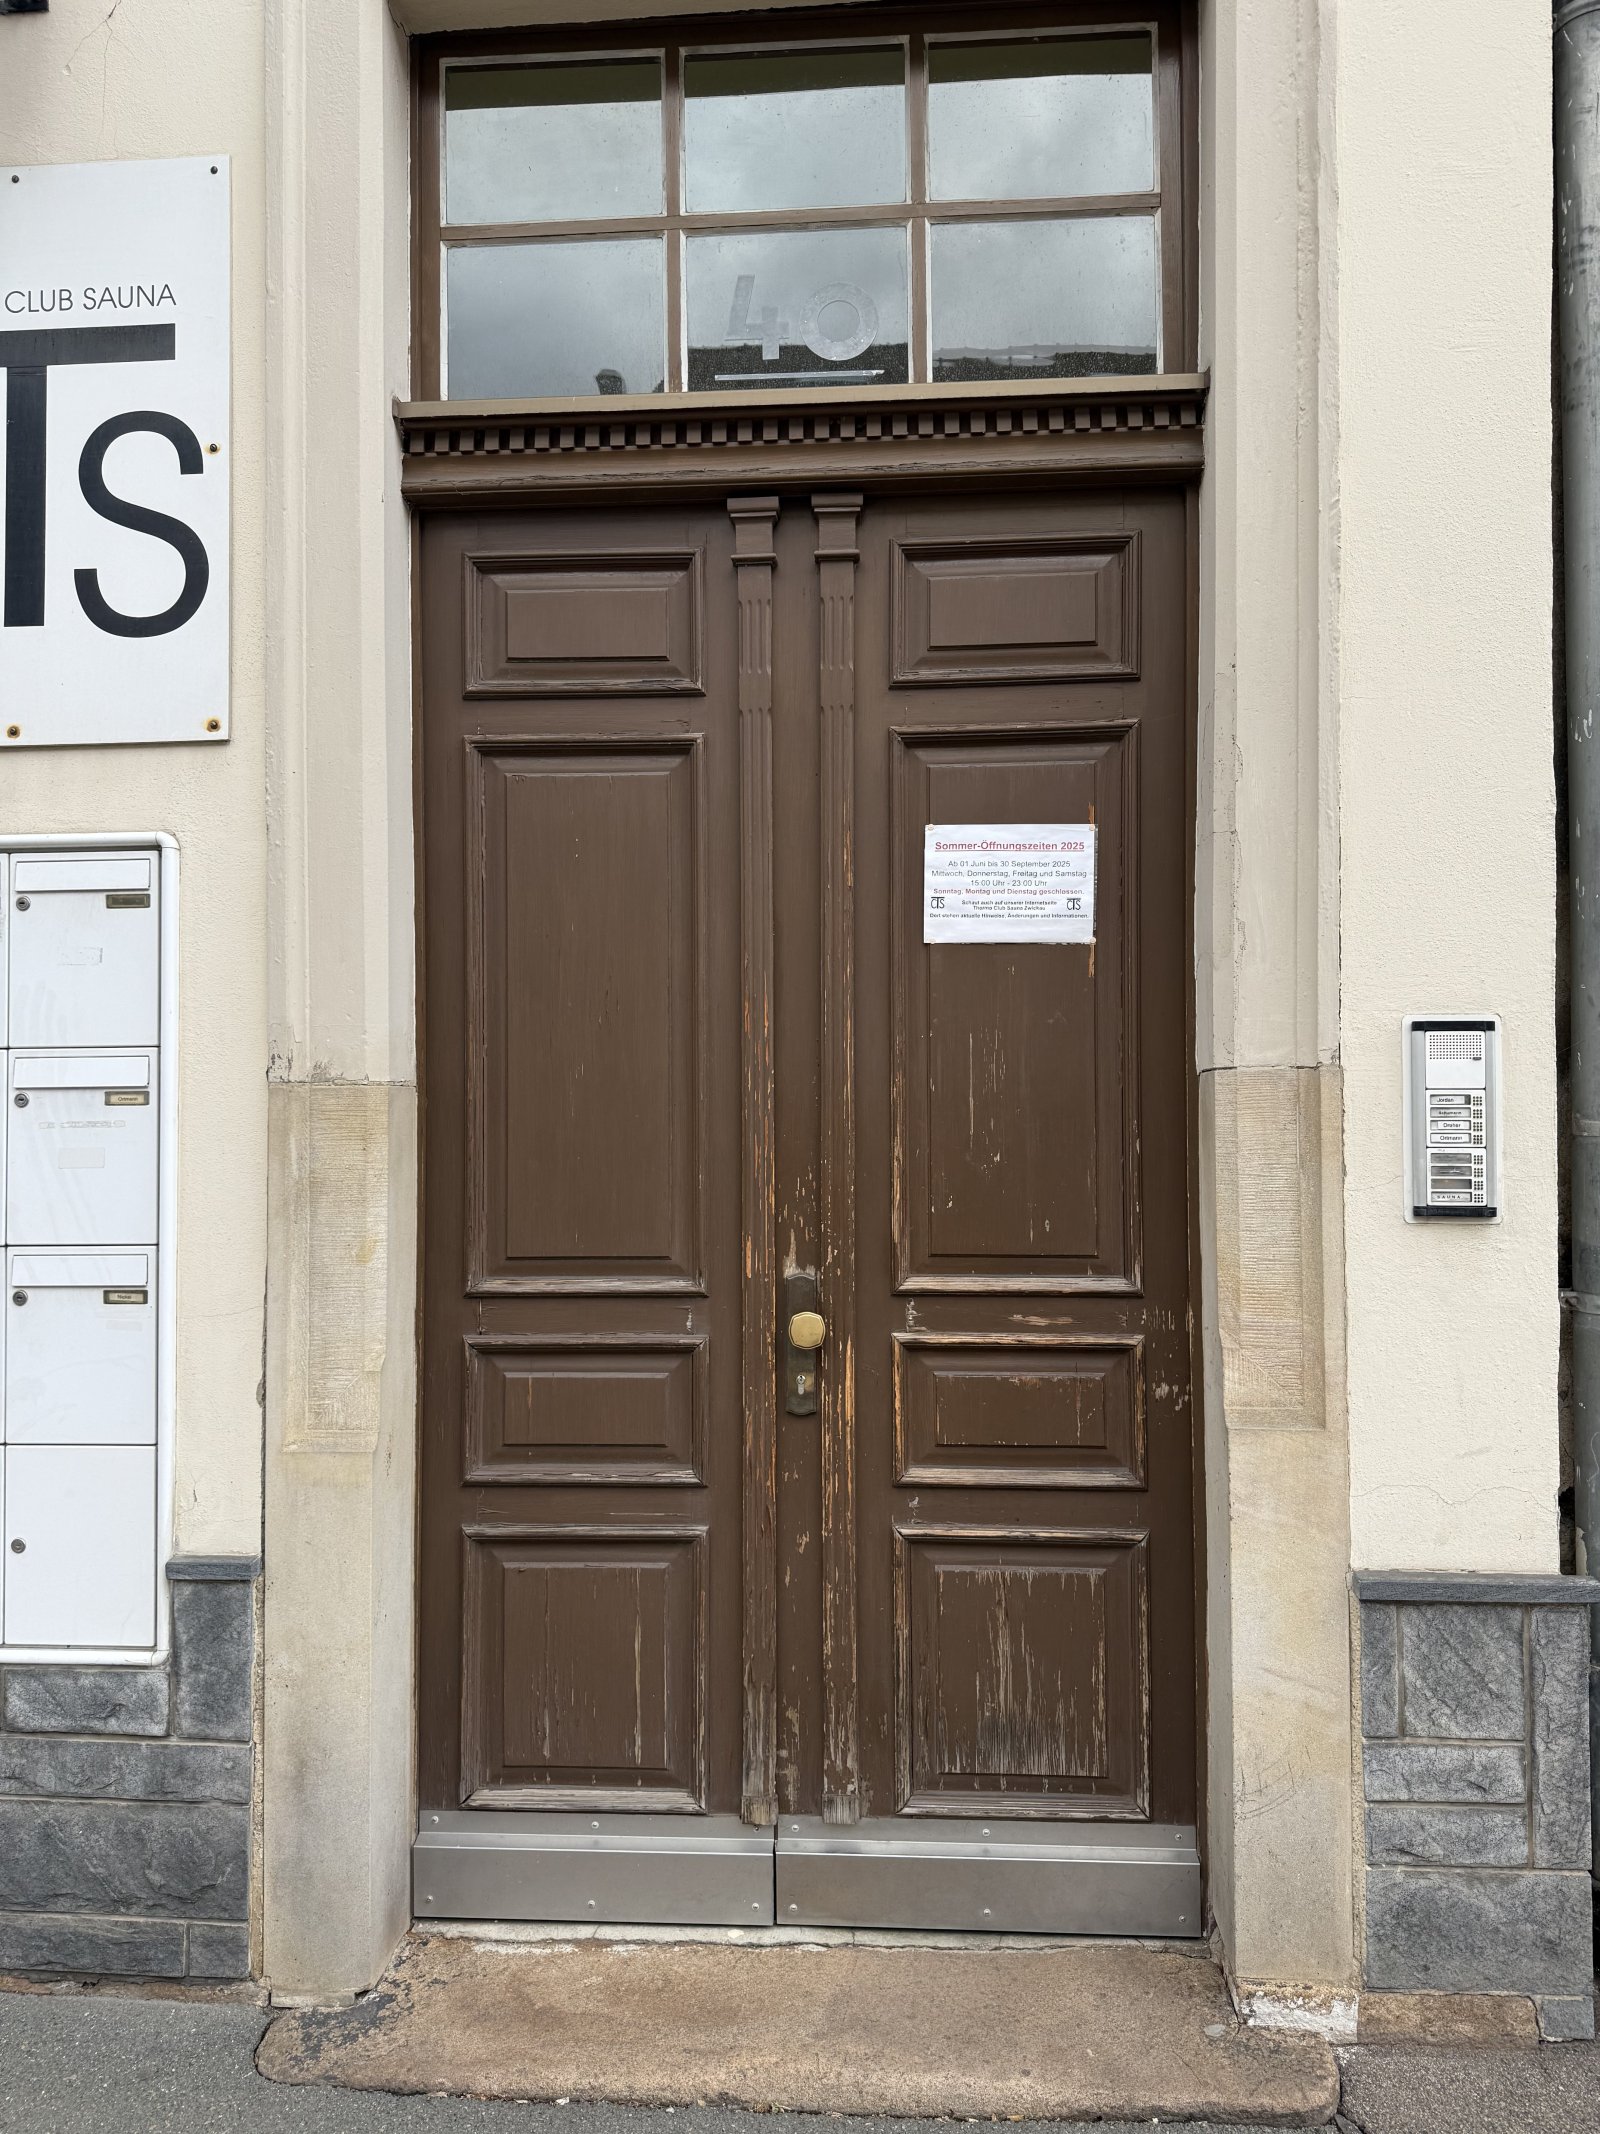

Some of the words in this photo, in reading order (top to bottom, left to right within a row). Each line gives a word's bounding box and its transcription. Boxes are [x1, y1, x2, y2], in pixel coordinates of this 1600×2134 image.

[5, 289, 73, 313] CLUB
[83, 284, 177, 310] SAUNA
[724, 275, 879, 361] 40
[935, 839, 1058, 852] Sommer-Öffnungszeiten
[1061, 841, 1085, 851] 2025
[1011, 860, 1050, 868] September
[967, 870, 1011, 878] Donnerstag,
[1012, 870, 1037, 878] Freitag
[1055, 870, 1087, 878] Samstag
[965, 888, 991, 896] Montag
[1007, 888, 1037, 896] Dienstag
